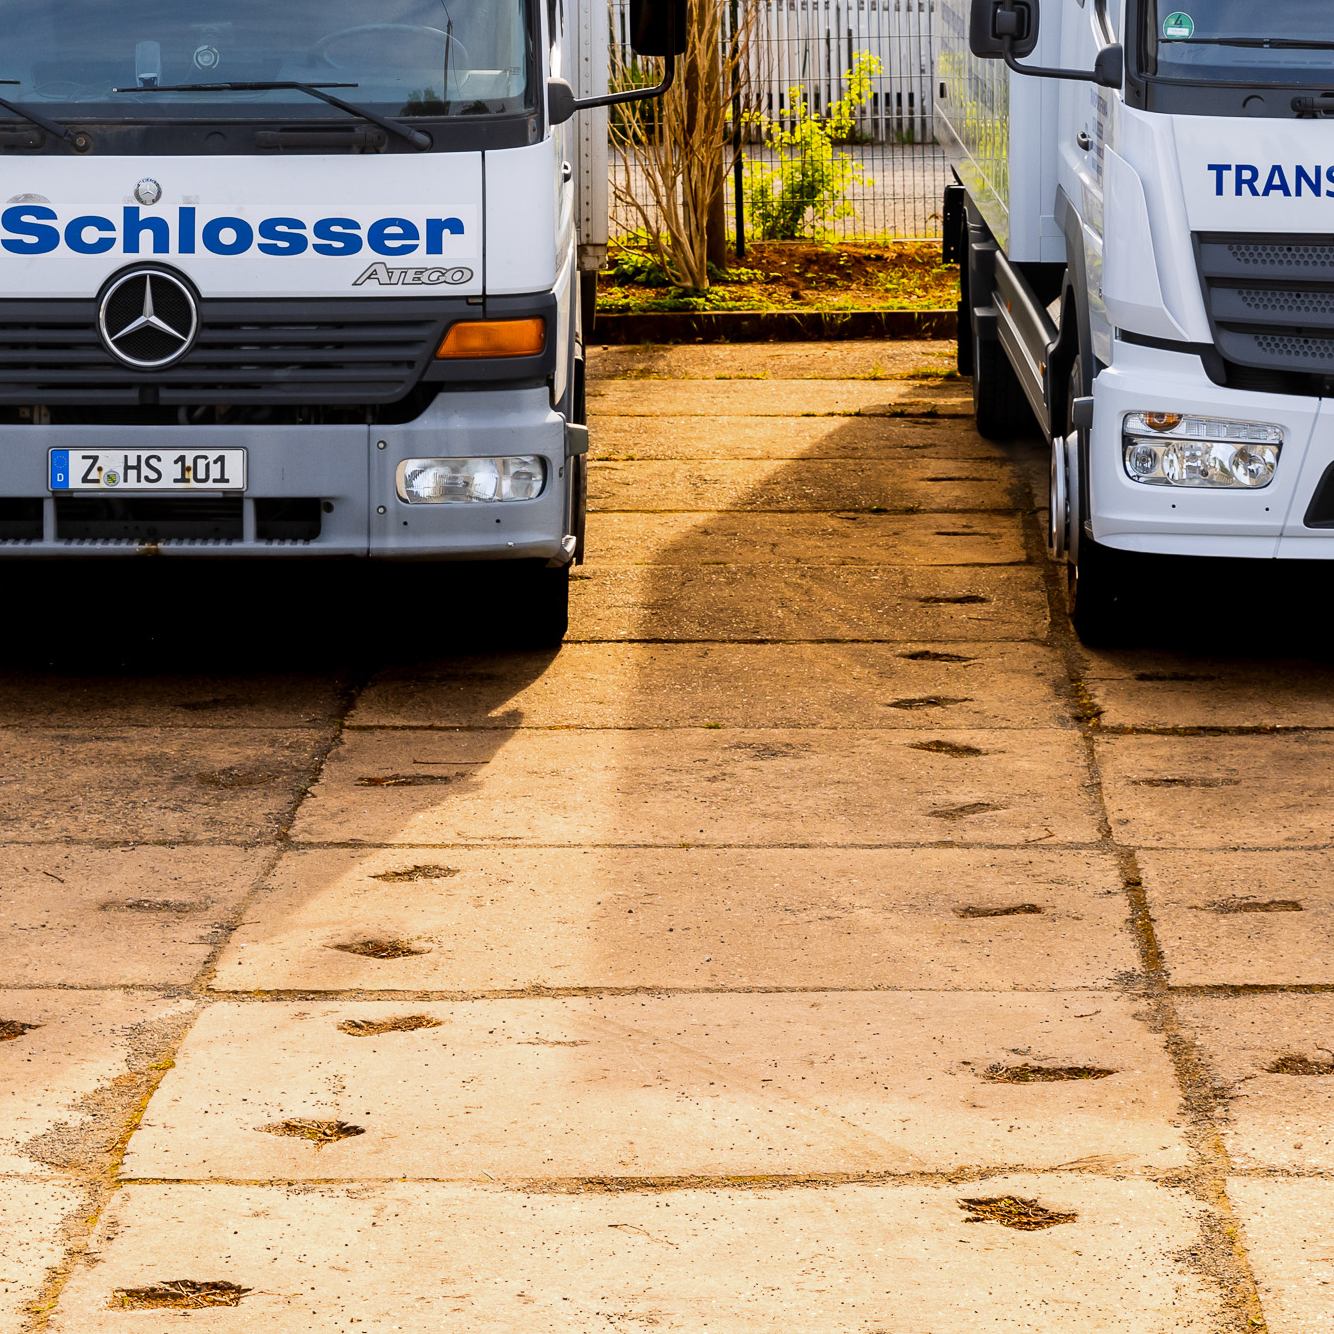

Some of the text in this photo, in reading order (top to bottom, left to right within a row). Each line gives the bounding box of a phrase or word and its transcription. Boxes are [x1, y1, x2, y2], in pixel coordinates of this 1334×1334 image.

[1174, 14, 1183, 28] 4
[0, 205, 465, 257] Schlosser
[57, 454, 230, 484] D Z HS 101
